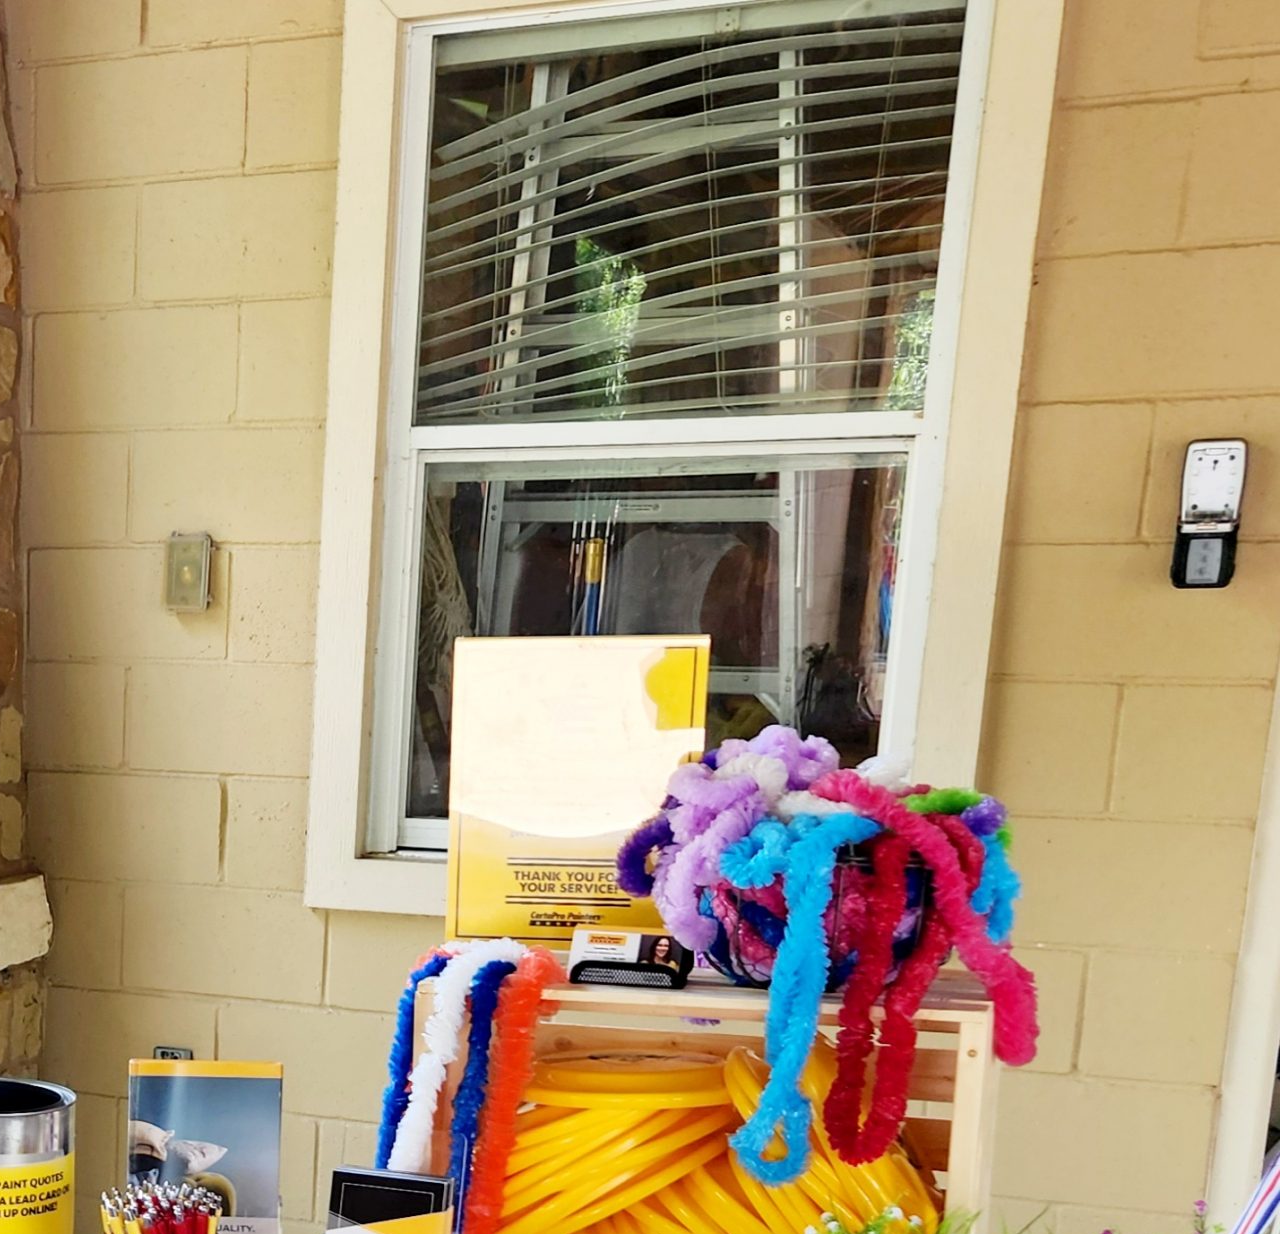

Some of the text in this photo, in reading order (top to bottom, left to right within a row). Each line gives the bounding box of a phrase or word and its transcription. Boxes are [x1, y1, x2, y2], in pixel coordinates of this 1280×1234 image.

[514, 871, 616, 882] THANK YOU FO
[520, 883, 618, 894] YOUR SERVICE!
[531, 911, 566, 920] CertaPro
[29, 1171, 64, 1189] QUOTES
[0, 1196, 7, 1206] A
[9, 1194, 37, 1205] LEAD
[38, 1187, 61, 1202] CARD
[3, 1208, 19, 1218] UP
